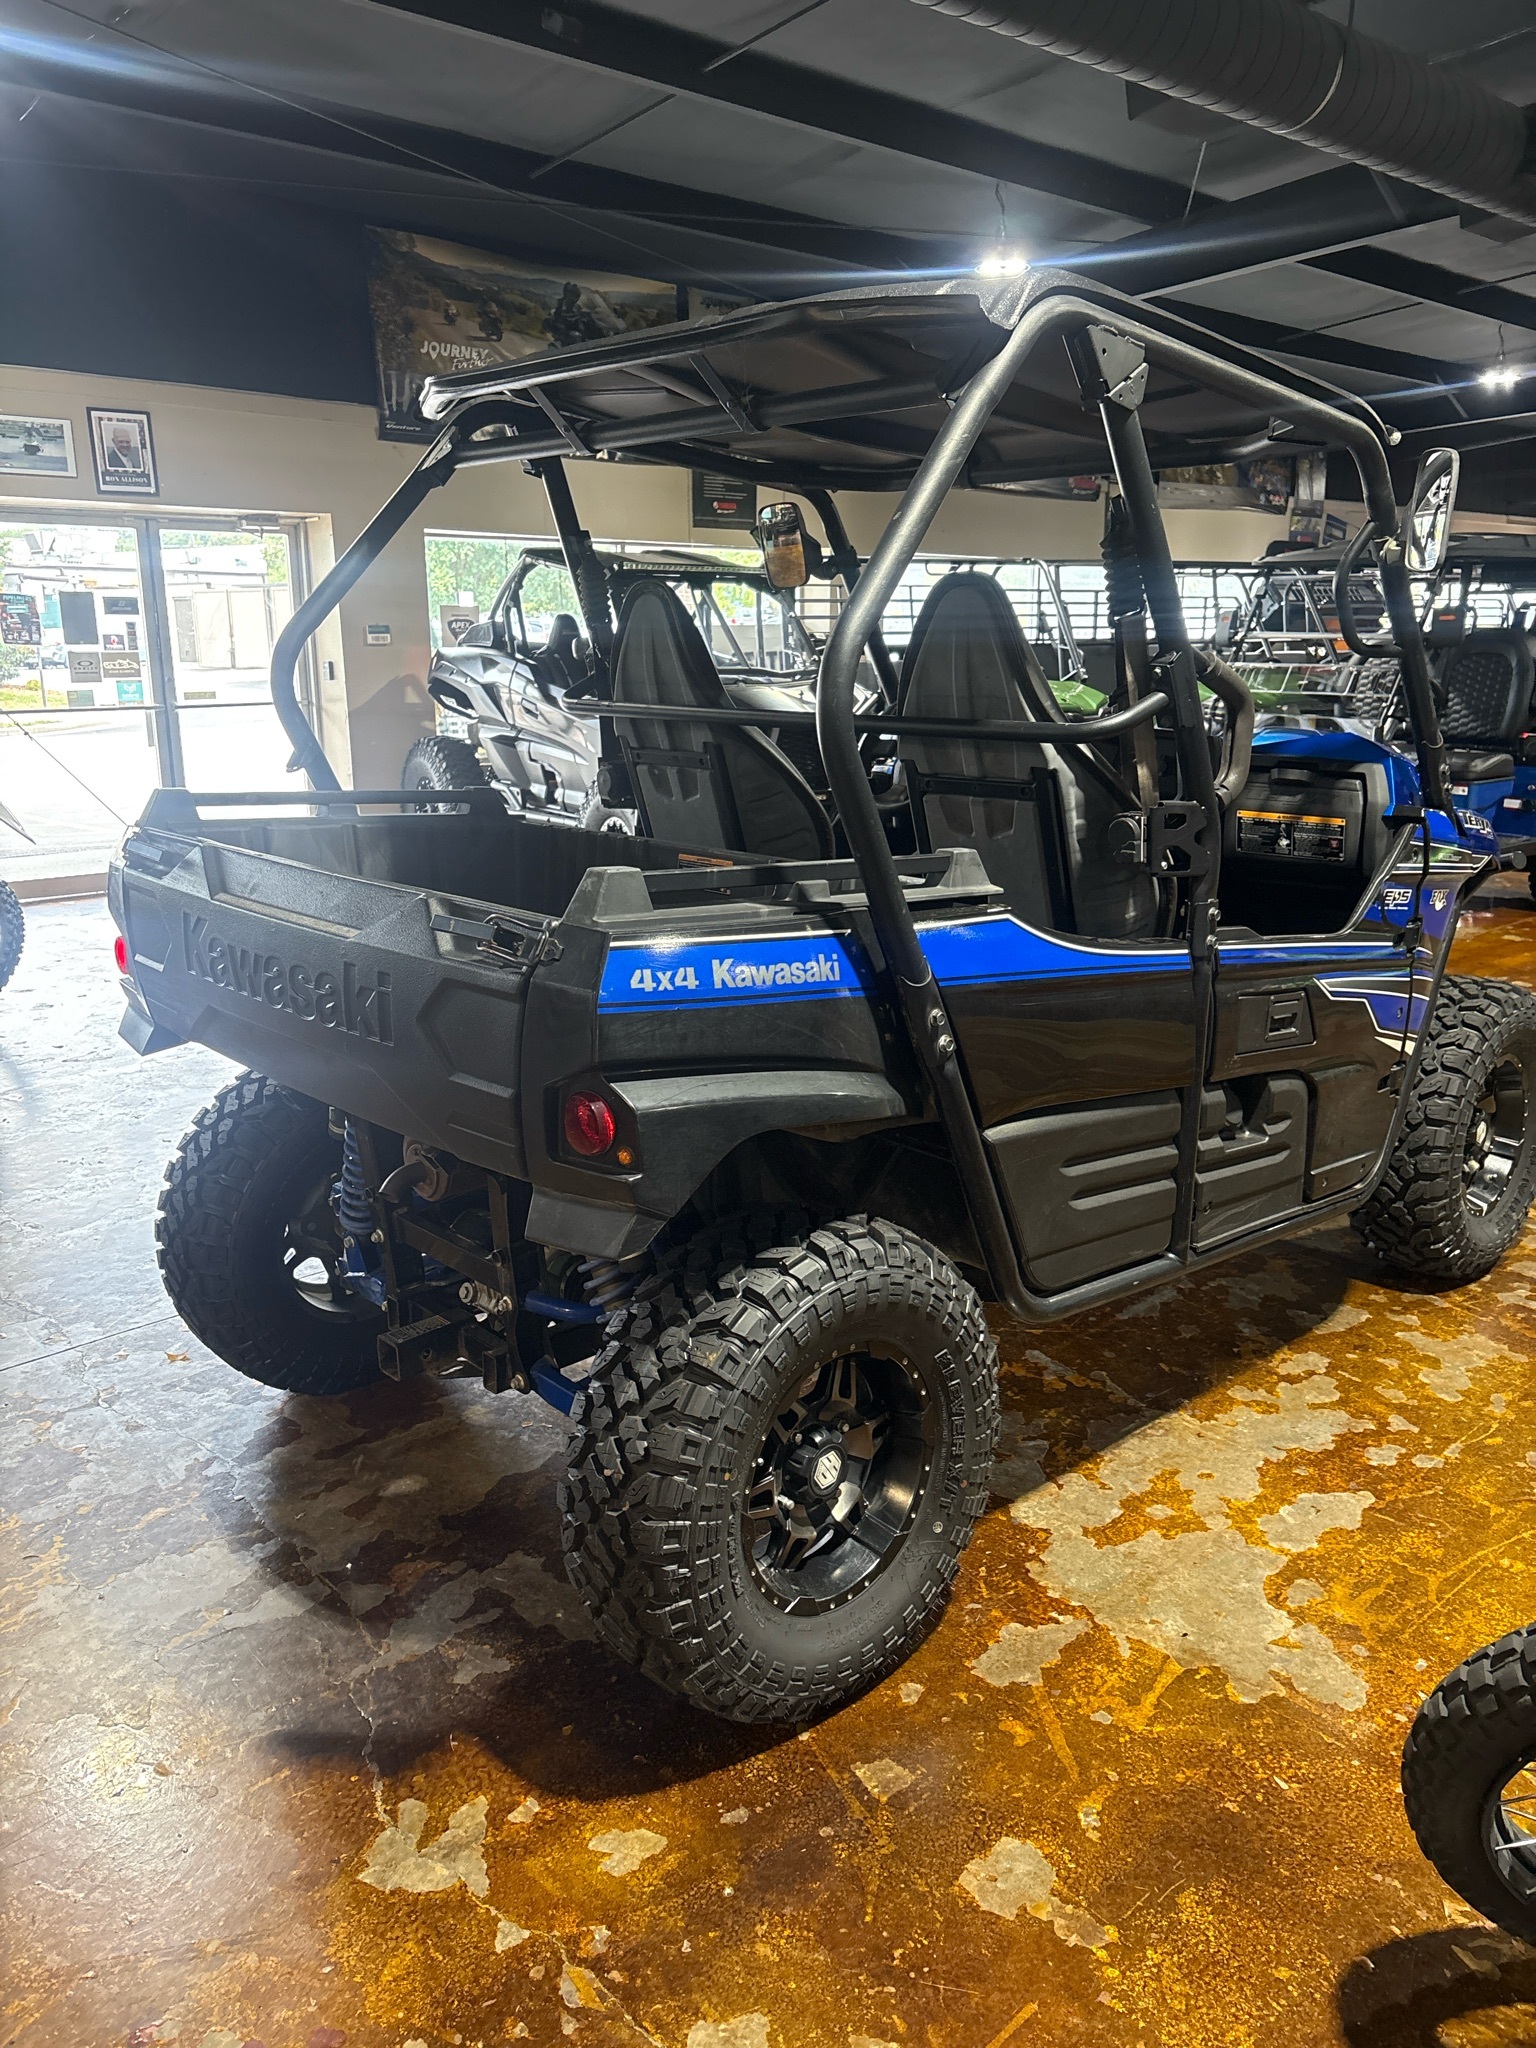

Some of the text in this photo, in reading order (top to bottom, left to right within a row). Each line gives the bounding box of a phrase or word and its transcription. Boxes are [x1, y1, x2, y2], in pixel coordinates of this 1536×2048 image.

[420, 340, 489, 360] JOURNEY
[452, 356, 494, 371] Further
[451, 621, 471, 629] APEX
[1383, 889, 1412, 907] EPS
[181, 910, 394, 1047] Kawasaki
[630, 953, 840, 992] 4x4 Kawasaki
